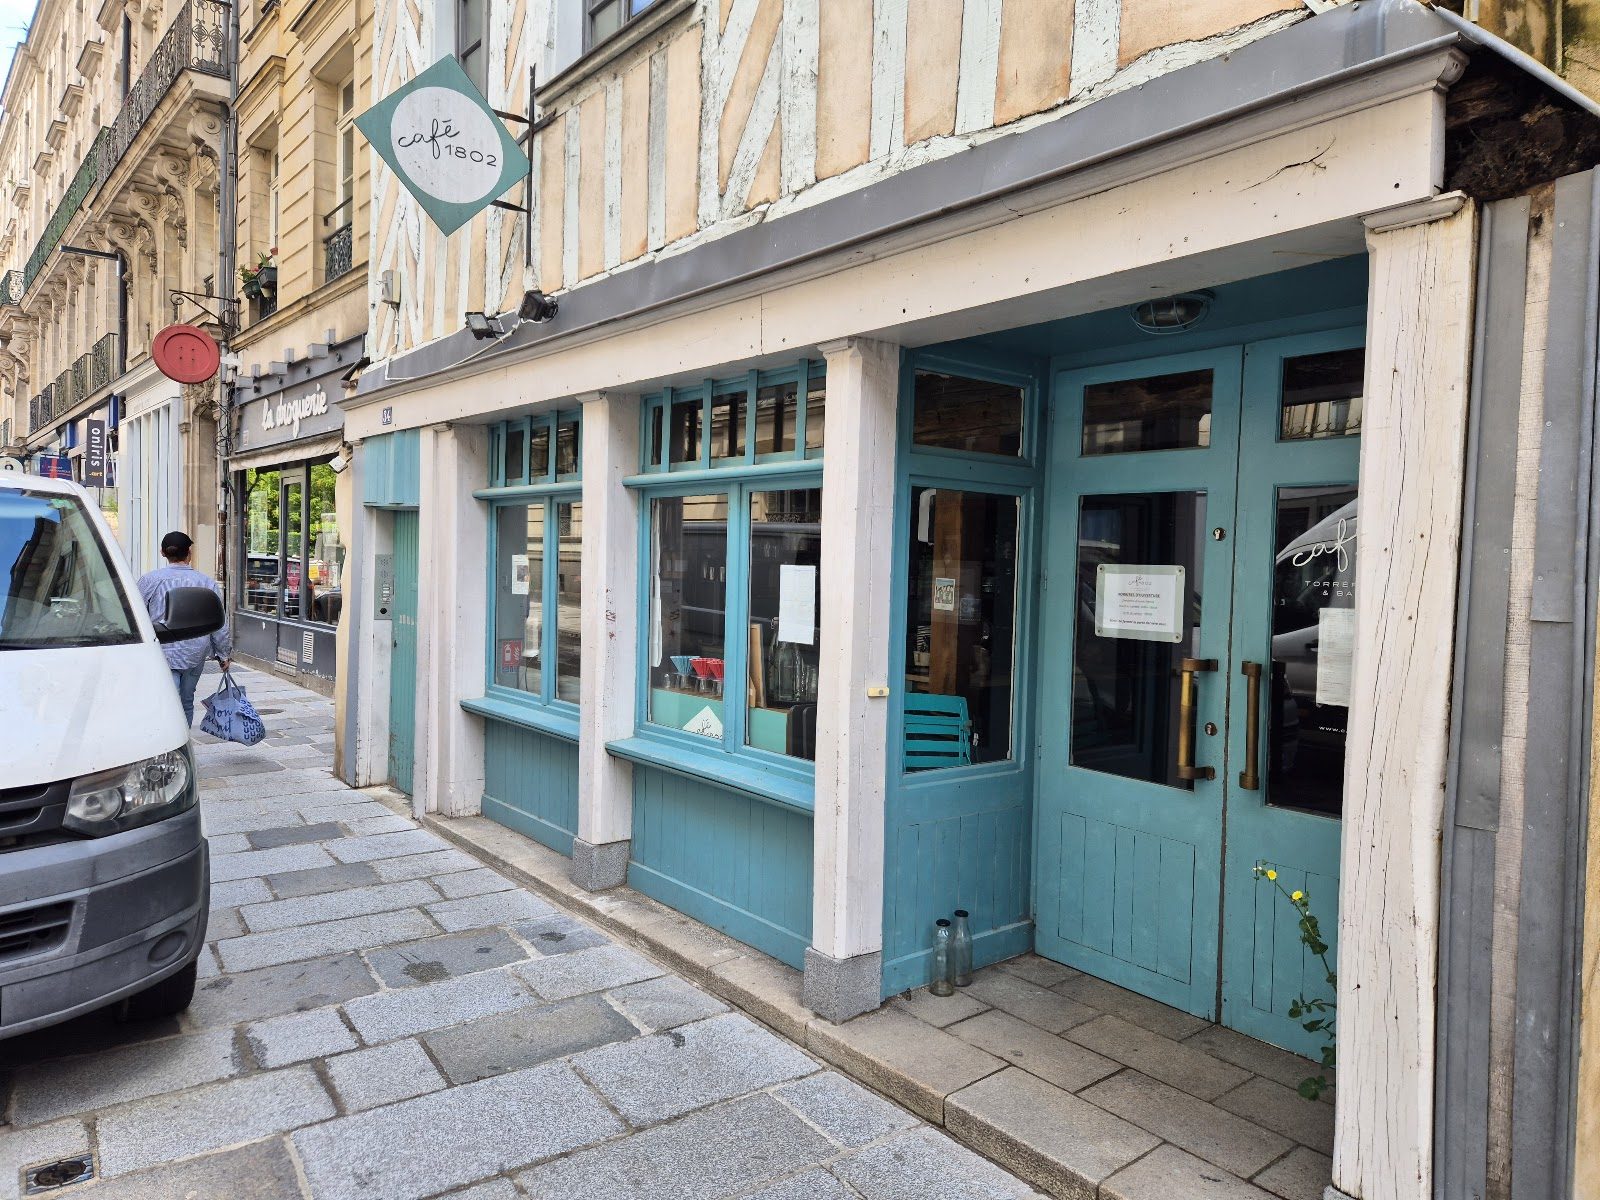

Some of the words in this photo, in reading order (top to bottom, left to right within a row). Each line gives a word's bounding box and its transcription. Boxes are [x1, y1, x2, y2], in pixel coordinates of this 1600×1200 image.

[398, 118, 460, 160] café
[444, 144, 497, 167] 1802
[276, 383, 329, 439] droguerie
[91, 427, 103, 467] oniris
[1292, 518, 1357, 572] caf
